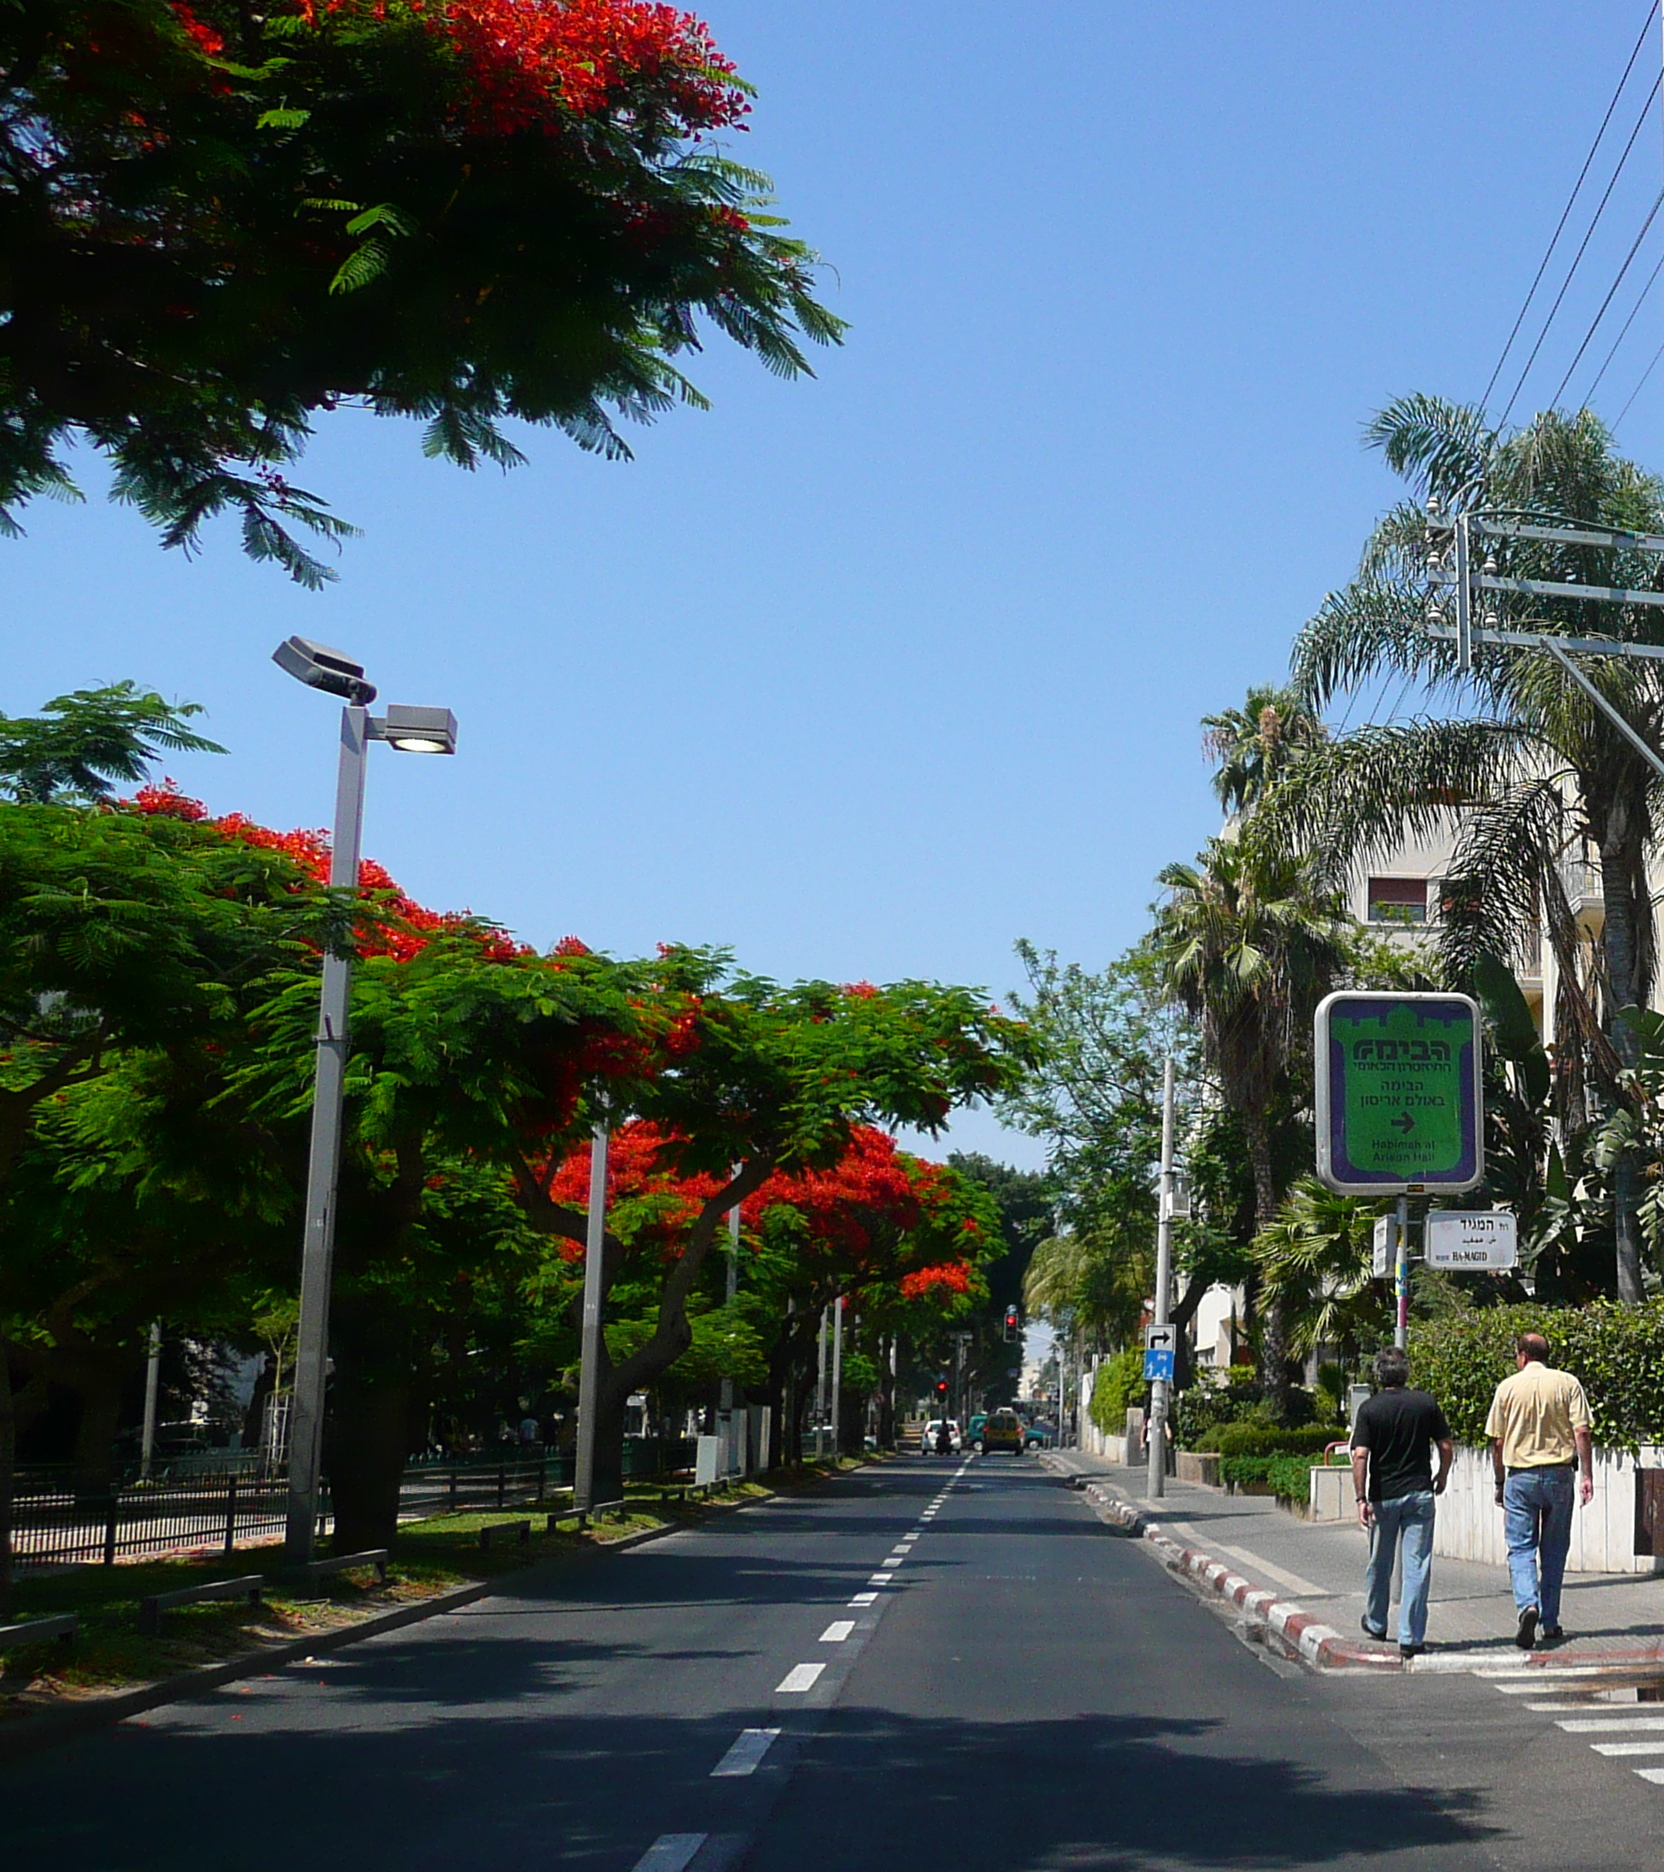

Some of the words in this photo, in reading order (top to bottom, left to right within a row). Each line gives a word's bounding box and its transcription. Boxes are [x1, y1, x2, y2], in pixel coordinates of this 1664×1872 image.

[1381, 1081, 1424, 1091] הבימה
[1361, 1095, 1400, 1108] אריסון
[1405, 1094, 1446, 1106] באולם
[1372, 1139, 1421, 1149] Habimah
[1373, 1152, 1410, 1161] Arison
[1413, 1152, 1435, 1161] Hall
[1460, 1219, 1494, 1230] המגיד
